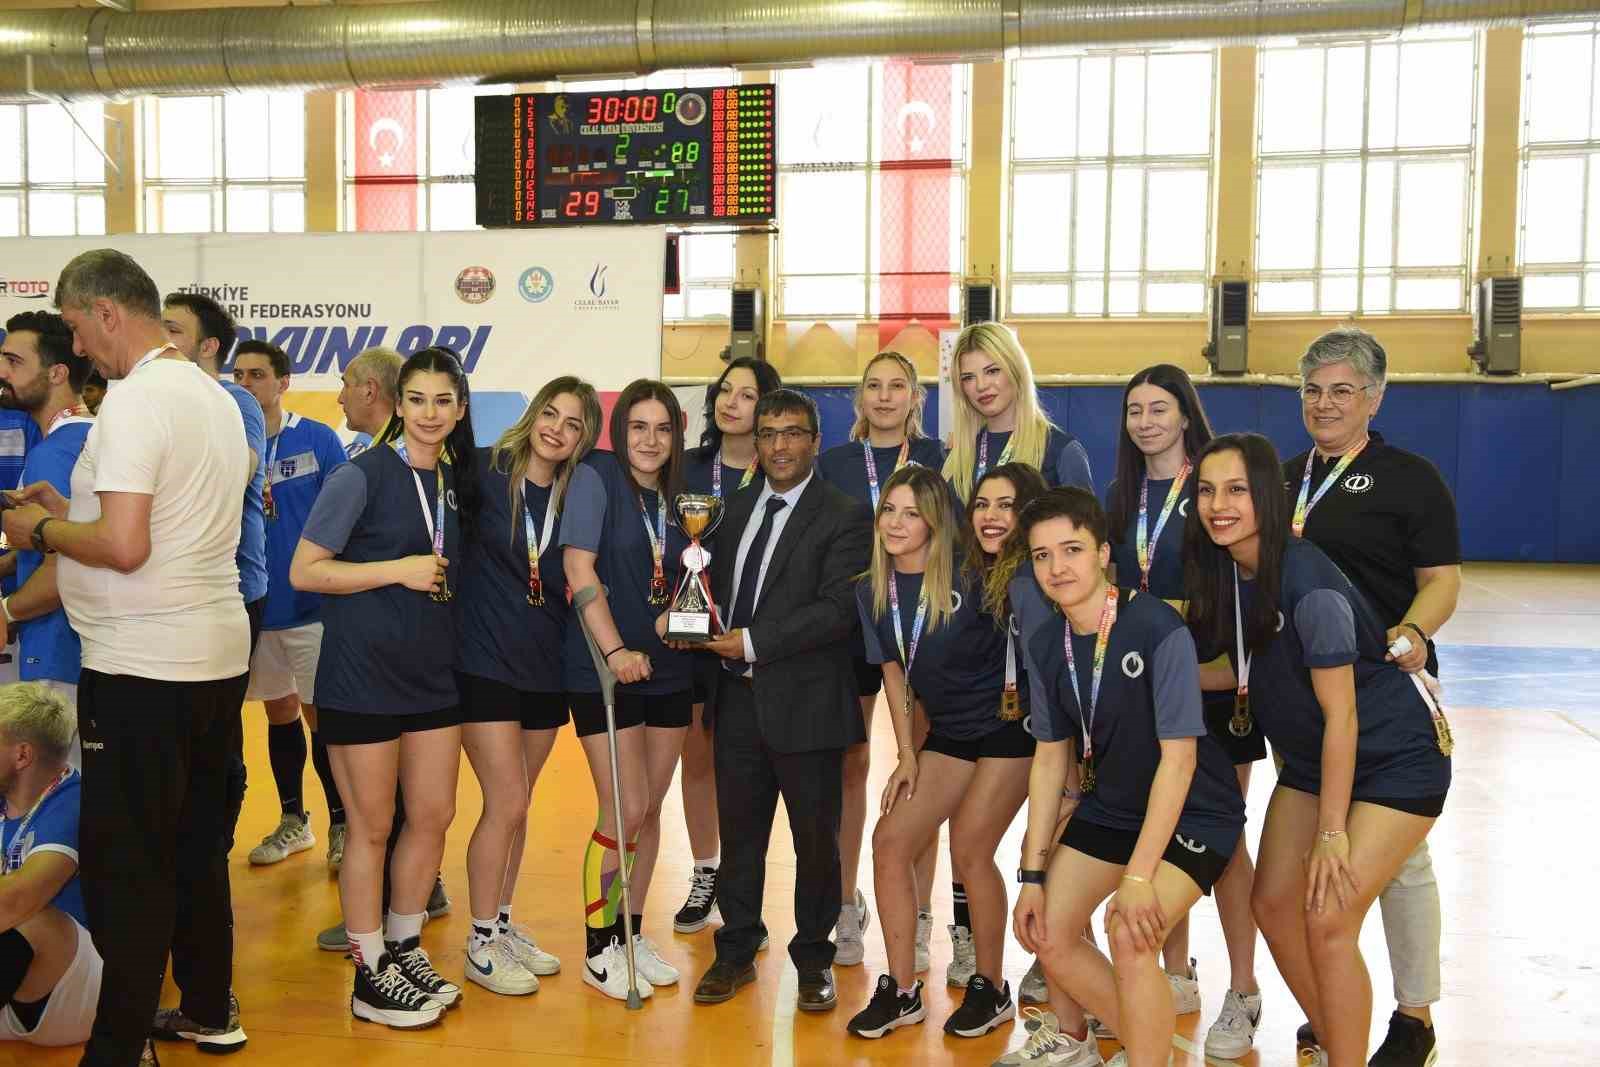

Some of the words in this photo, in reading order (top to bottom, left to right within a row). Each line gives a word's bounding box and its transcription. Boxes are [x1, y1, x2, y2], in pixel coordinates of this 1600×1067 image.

[588, 96, 657, 123] 30:00
[663, 92, 676, 113] 0
[616, 134, 630, 158] 2
[566, 191, 600, 216] 29
[655, 189, 689, 214] 27
[251, 303, 371, 318] FEDERASYONU
